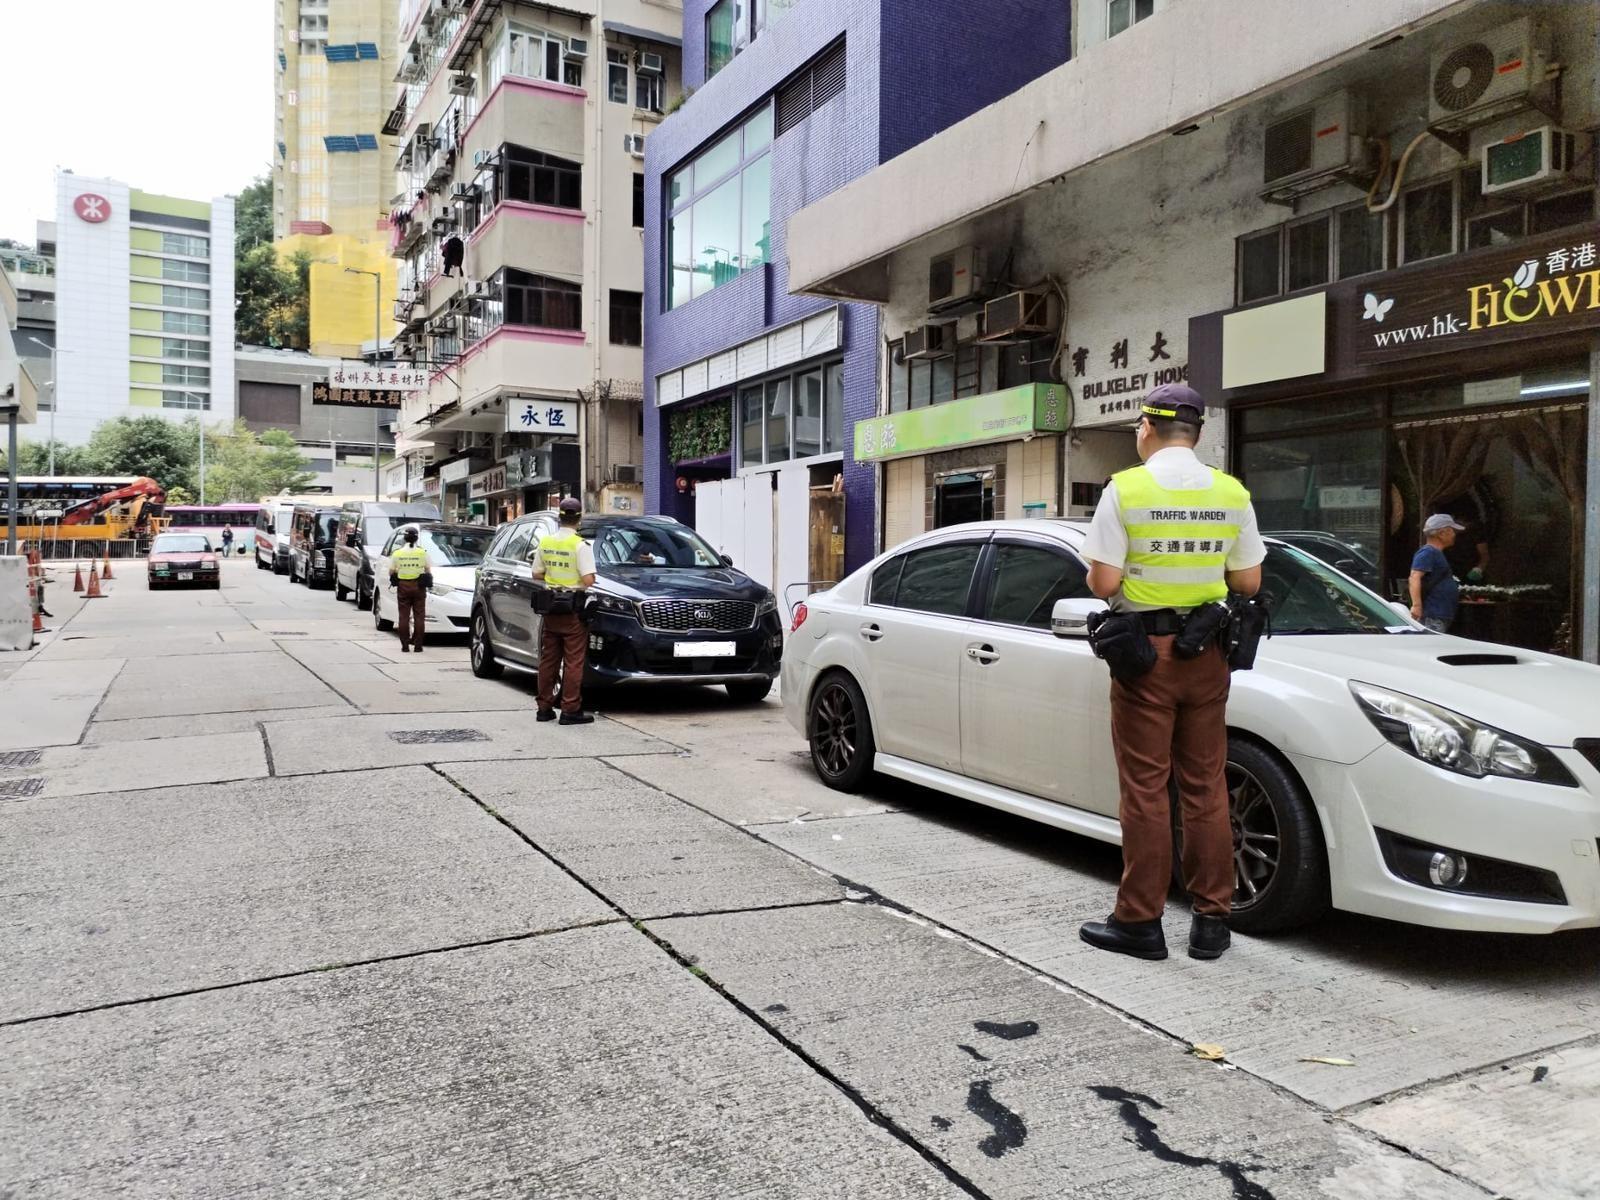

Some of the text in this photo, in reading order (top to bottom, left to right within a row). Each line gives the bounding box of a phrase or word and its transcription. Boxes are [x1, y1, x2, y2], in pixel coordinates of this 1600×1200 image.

[1546, 242, 1597, 275] 香港
[1083, 373, 1148, 400] BULKELEY
[1150, 510, 1226, 521] TRAFFIC WARDEN
[1150, 540, 1224, 553] 交通督導員
[697, 609, 712, 619] KIA
